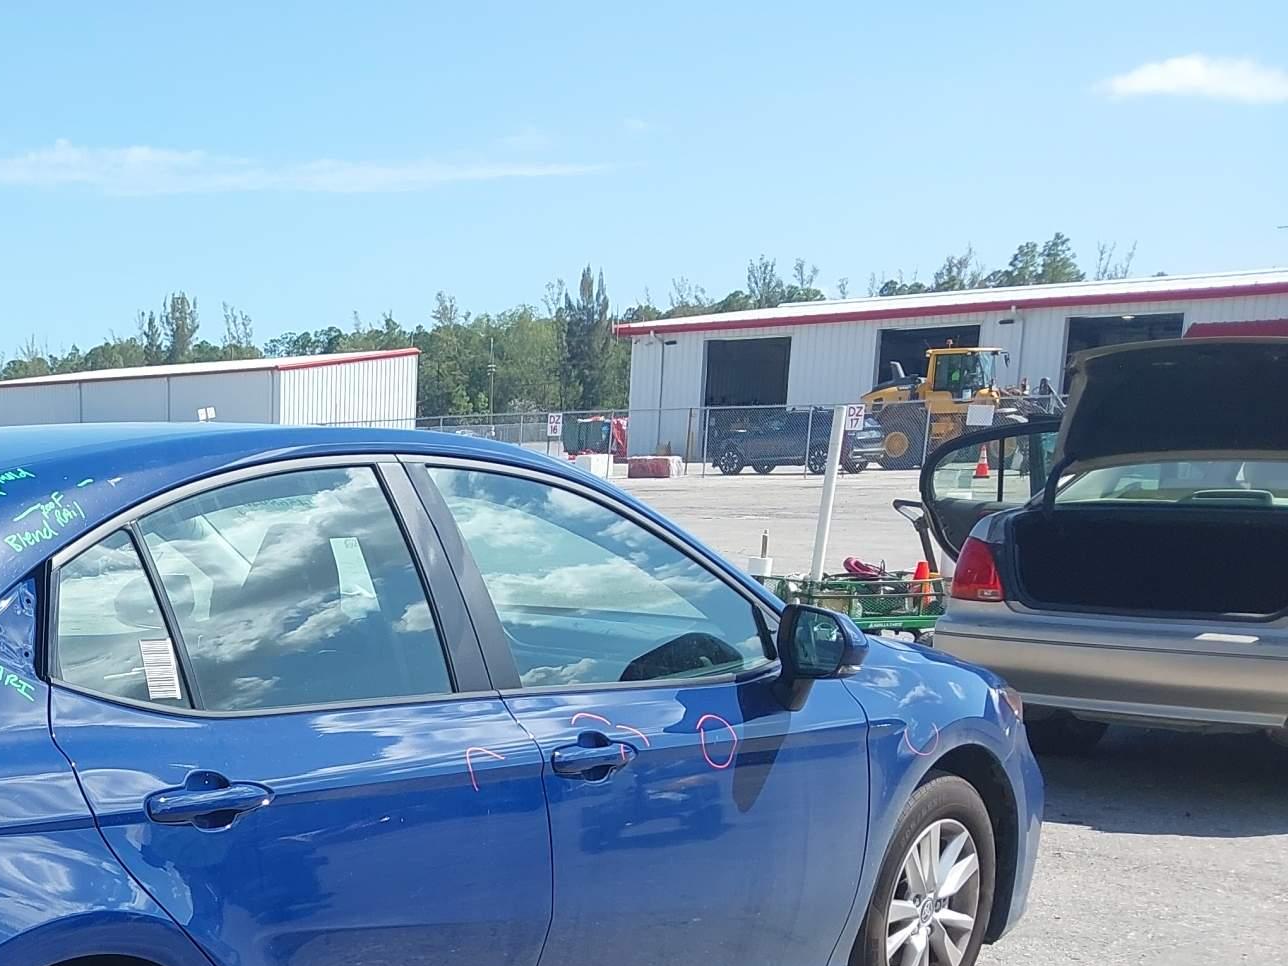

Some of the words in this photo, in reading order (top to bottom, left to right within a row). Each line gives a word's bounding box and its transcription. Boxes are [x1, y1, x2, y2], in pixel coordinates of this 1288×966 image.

[848, 406, 863, 417] DZ
[549, 415, 560, 424] DZ
[850, 417, 860, 429] 17
